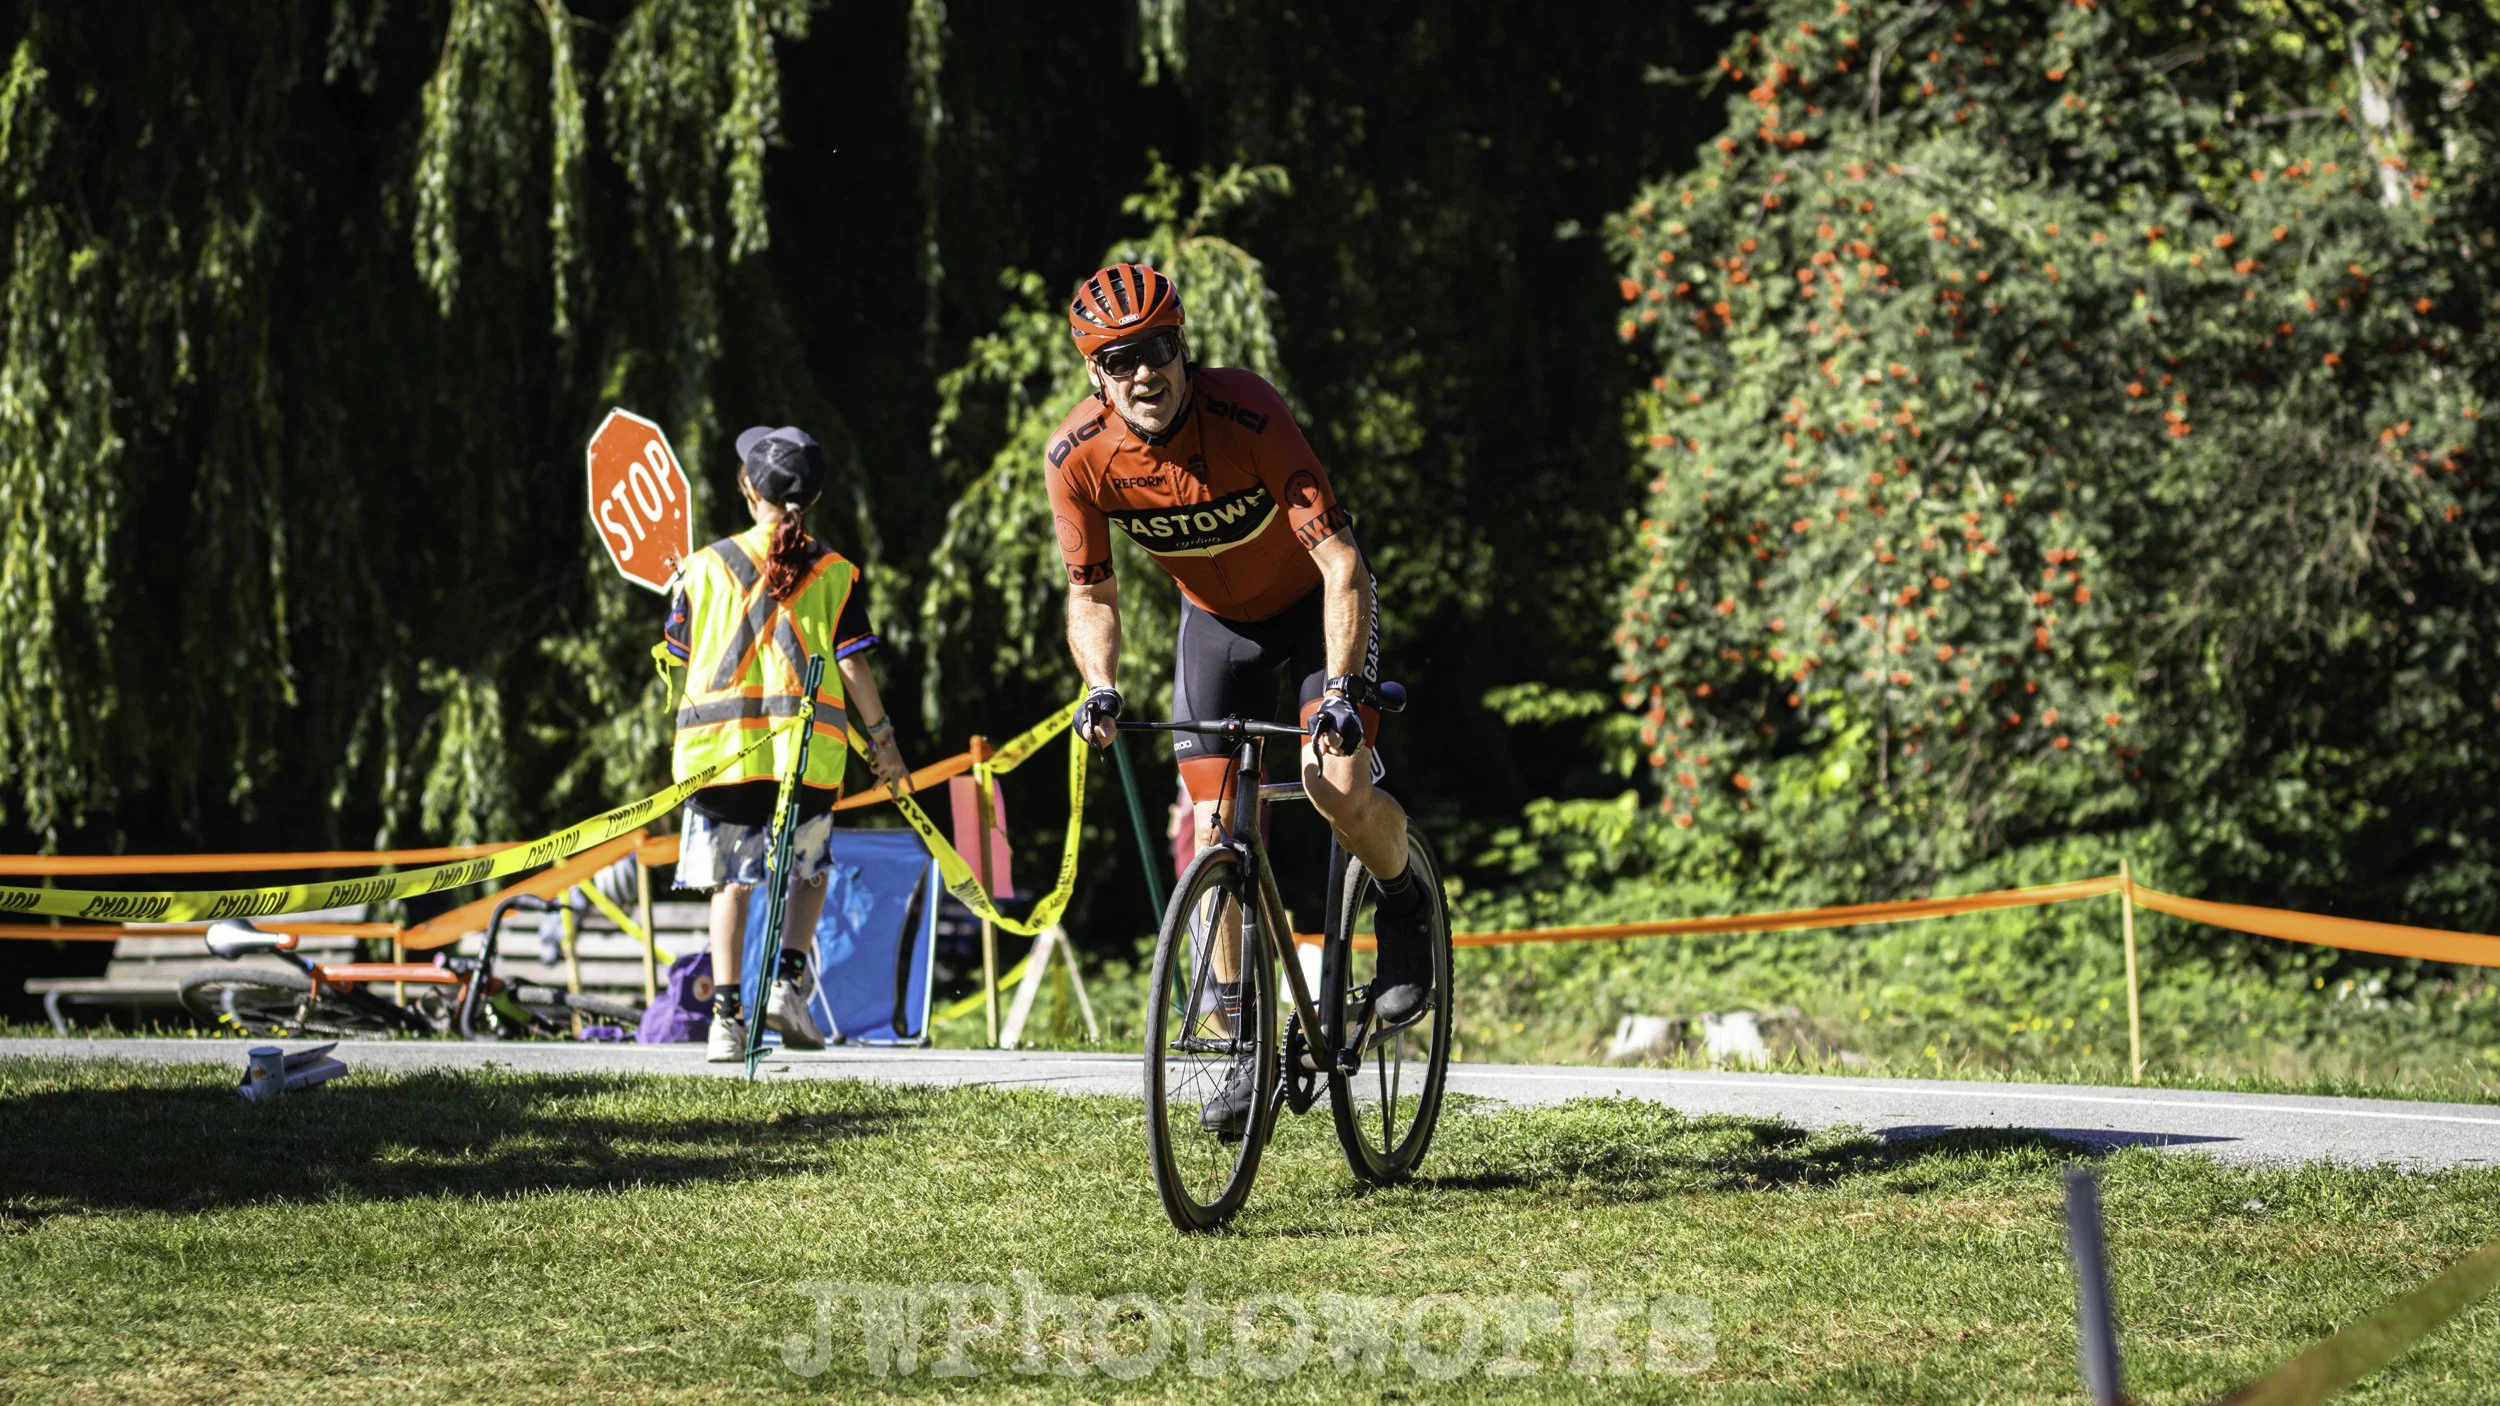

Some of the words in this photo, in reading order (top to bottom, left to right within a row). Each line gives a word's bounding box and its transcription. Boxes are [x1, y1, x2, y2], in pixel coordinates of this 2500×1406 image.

[600, 439, 676, 561] STOP
[1113, 475, 1168, 490] REFORM
[1364, 573, 1379, 683] GASTOWN
